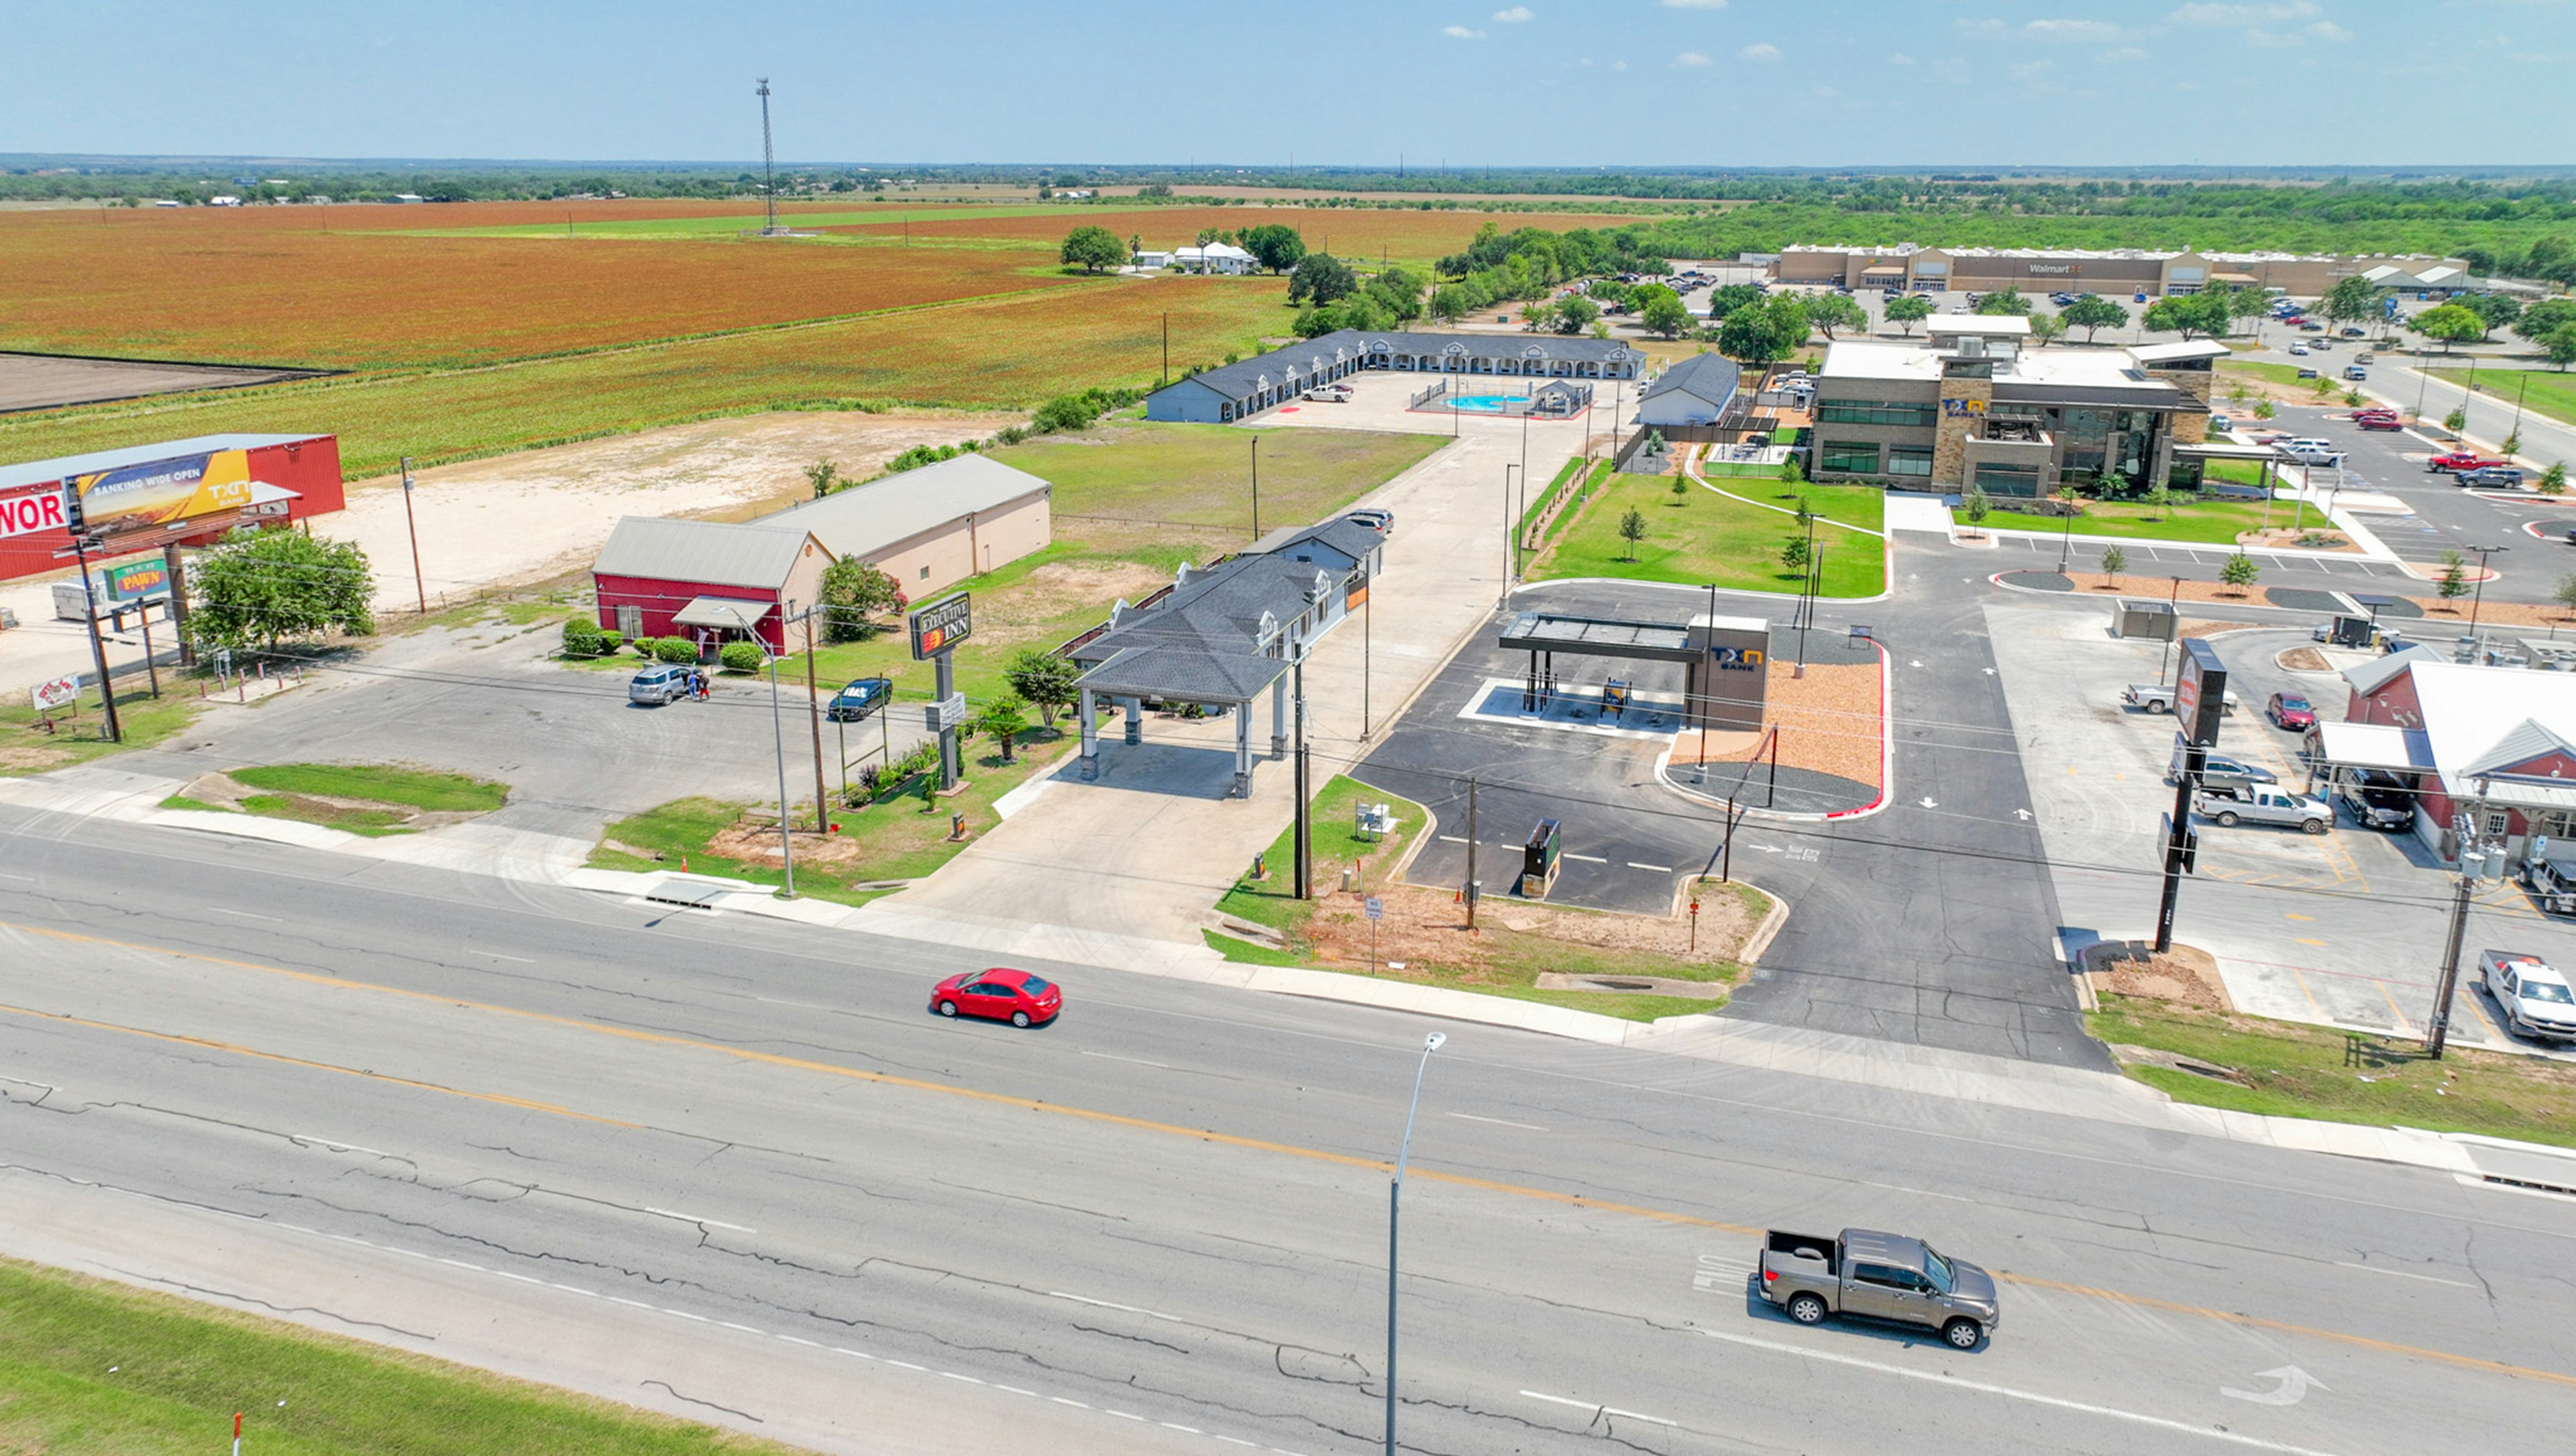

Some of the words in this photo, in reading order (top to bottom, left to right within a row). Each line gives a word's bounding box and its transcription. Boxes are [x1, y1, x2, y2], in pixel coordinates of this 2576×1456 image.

[2029, 264, 2070, 273] Walmart
[94, 479, 143, 497] BANKING
[145, 473, 171, 486] WIDE
[173, 468, 201, 481] OPEN
[123, 571, 160, 590] PAWN
[923, 601, 967, 631] EXECUTIVE
[944, 617, 968, 641] INN
[1721, 664, 1754, 672] BANK
